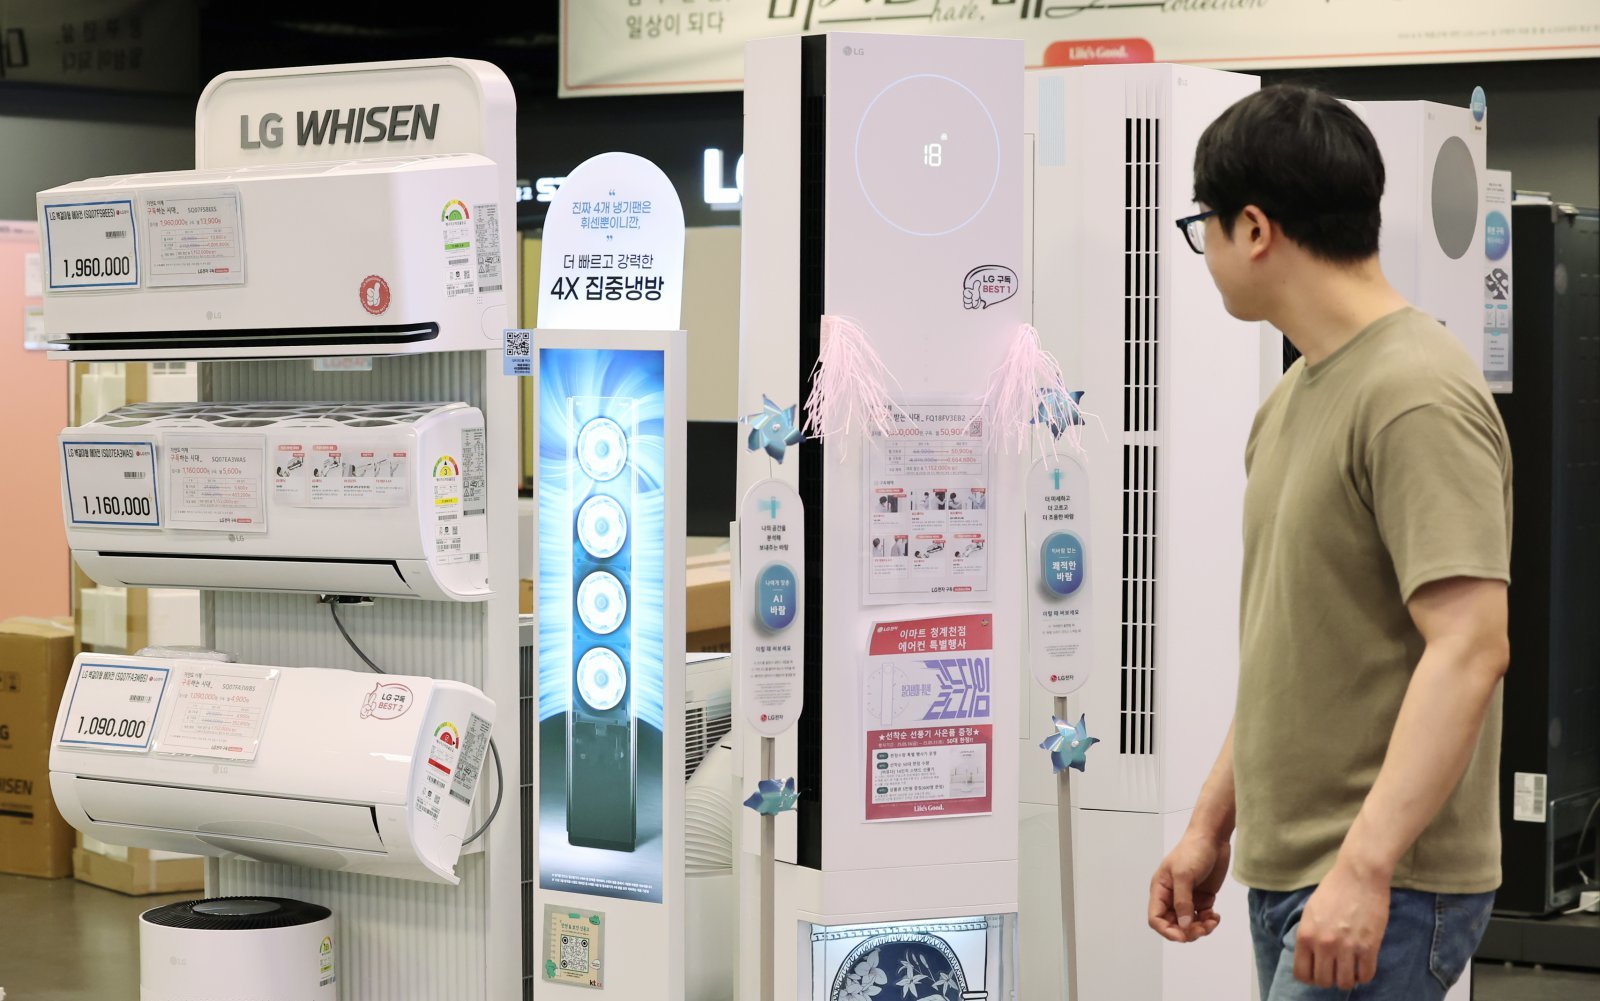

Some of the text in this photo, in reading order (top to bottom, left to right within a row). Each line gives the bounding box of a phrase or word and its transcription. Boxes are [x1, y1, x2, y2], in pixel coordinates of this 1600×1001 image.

[687, 11, 724, 34] 되다
[853, 47, 865, 57] LG
[240, 102, 440, 149] LG WHISEN
[924, 143, 942, 167] 18
[704, 149, 744, 204] L
[572, 200, 652, 215] 진짜 4개 냉기팬은
[581, 216, 641, 230] 휘센뿐이니깐,
[64, 256, 130, 278] 1,960,000
[563, 254, 654, 269] 더 빠르고 강력한
[983, 275, 1011, 284] LG 구독
[550, 276, 665, 301] 4X 집중냉방
[925, 414, 965, 422] FQ18FV3EB2
[83, 496, 151, 516] 1,160,000
[1052, 560, 1076, 571] 쾌적한
[1056, 571, 1073, 582] 바람
[773, 594, 783, 603] AI
[770, 605, 786, 616] 바람
[900, 625, 967, 640] 이마트 청계천점
[898, 638, 967, 653] 에어컨 특별행사
[381, 693, 406, 703] LG 구독
[378, 701, 399, 712] BEST
[78, 716, 146, 739] 1,090,000
[910, 730, 932, 739] 선풍기
[914, 803, 944, 812] Life's Good.
